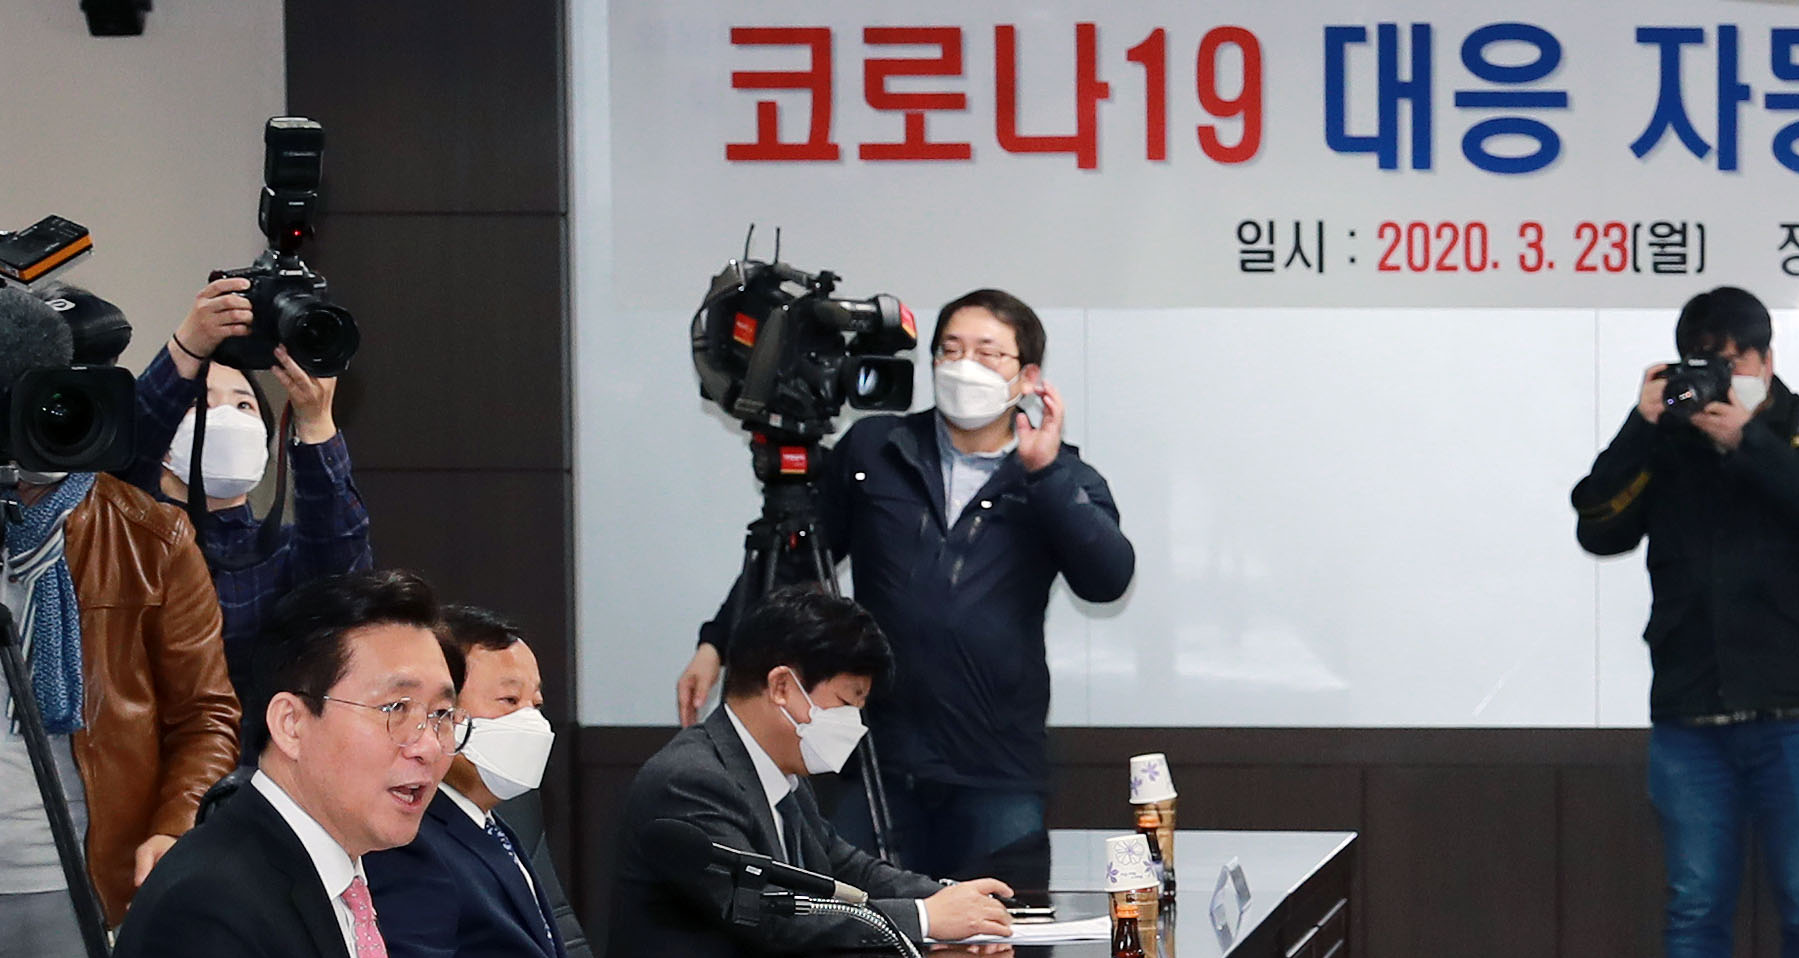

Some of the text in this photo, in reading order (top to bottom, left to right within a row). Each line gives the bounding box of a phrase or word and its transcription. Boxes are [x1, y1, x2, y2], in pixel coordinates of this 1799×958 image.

[726, 23, 1263, 170] 코로나19
[1325, 22, 1568, 174] 대응
[1236, 219, 1325, 275] 일시
[1377, 220, 1500, 274] 2020.
[1518, 220, 1556, 274] 3.
[1574, 220, 1709, 276] 23(월)
